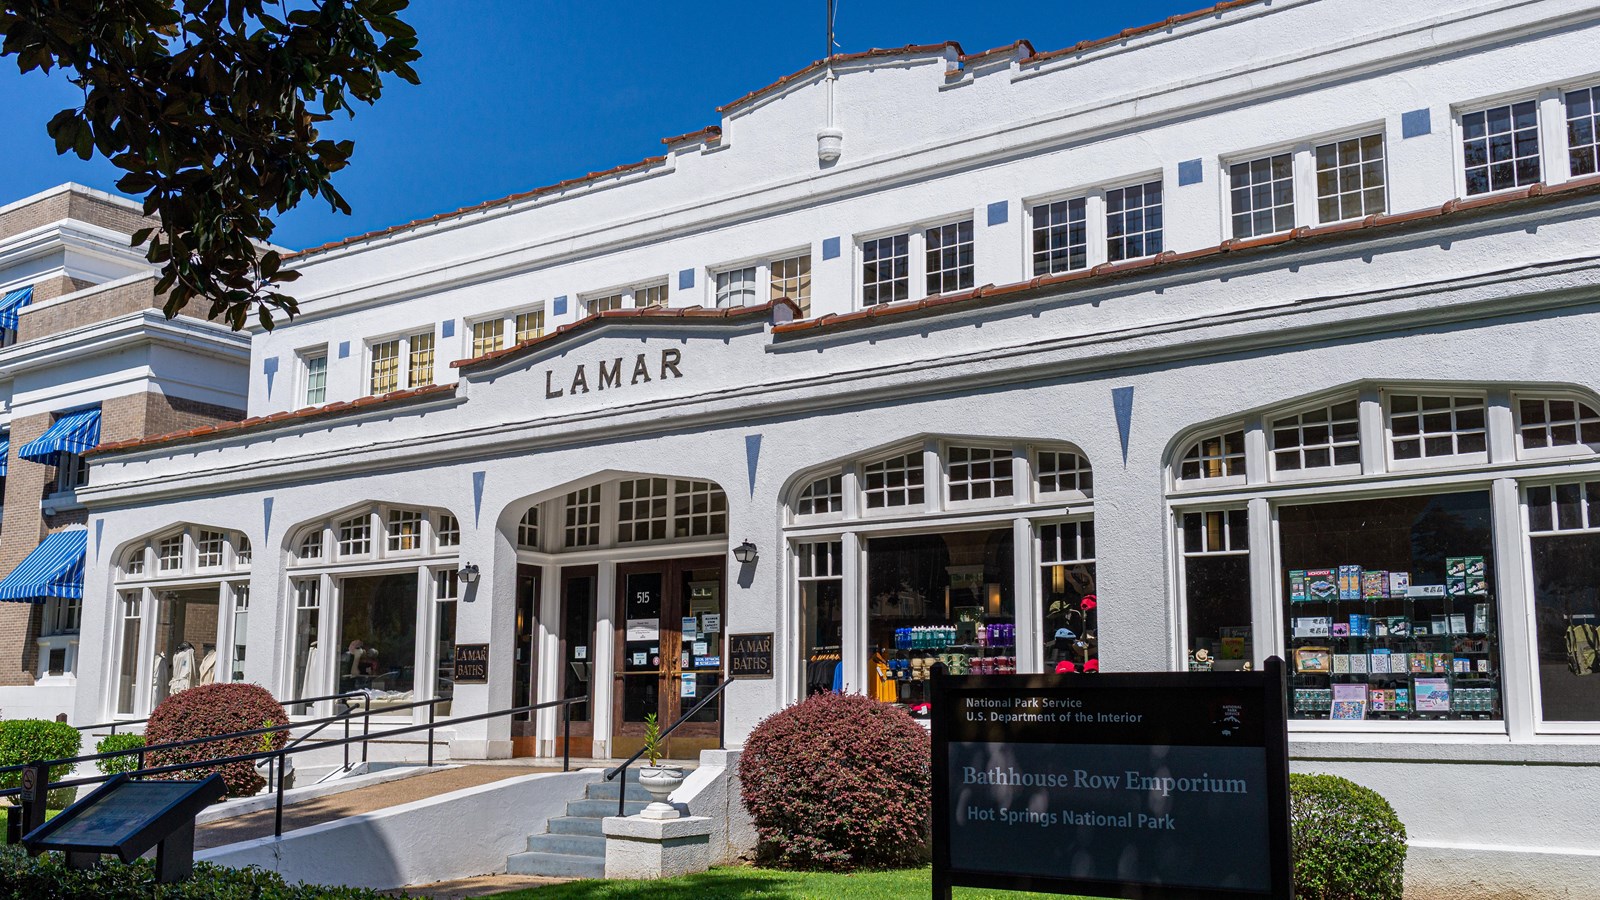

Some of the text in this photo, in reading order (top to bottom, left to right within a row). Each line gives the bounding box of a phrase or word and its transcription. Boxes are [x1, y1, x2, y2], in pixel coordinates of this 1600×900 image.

[545, 348, 684, 400] LAMAR
[636, 591, 650, 604] 515
[458, 664, 484, 675] BATHS
[733, 657, 768, 670] BATHS
[966, 697, 1082, 708] National Park Service
[966, 711, 1142, 724] U.S. Department of the Interior
[962, 766, 1248, 797] Bathhouse Row Emporium
[967, 806, 1176, 830] Hot Springs National Park
